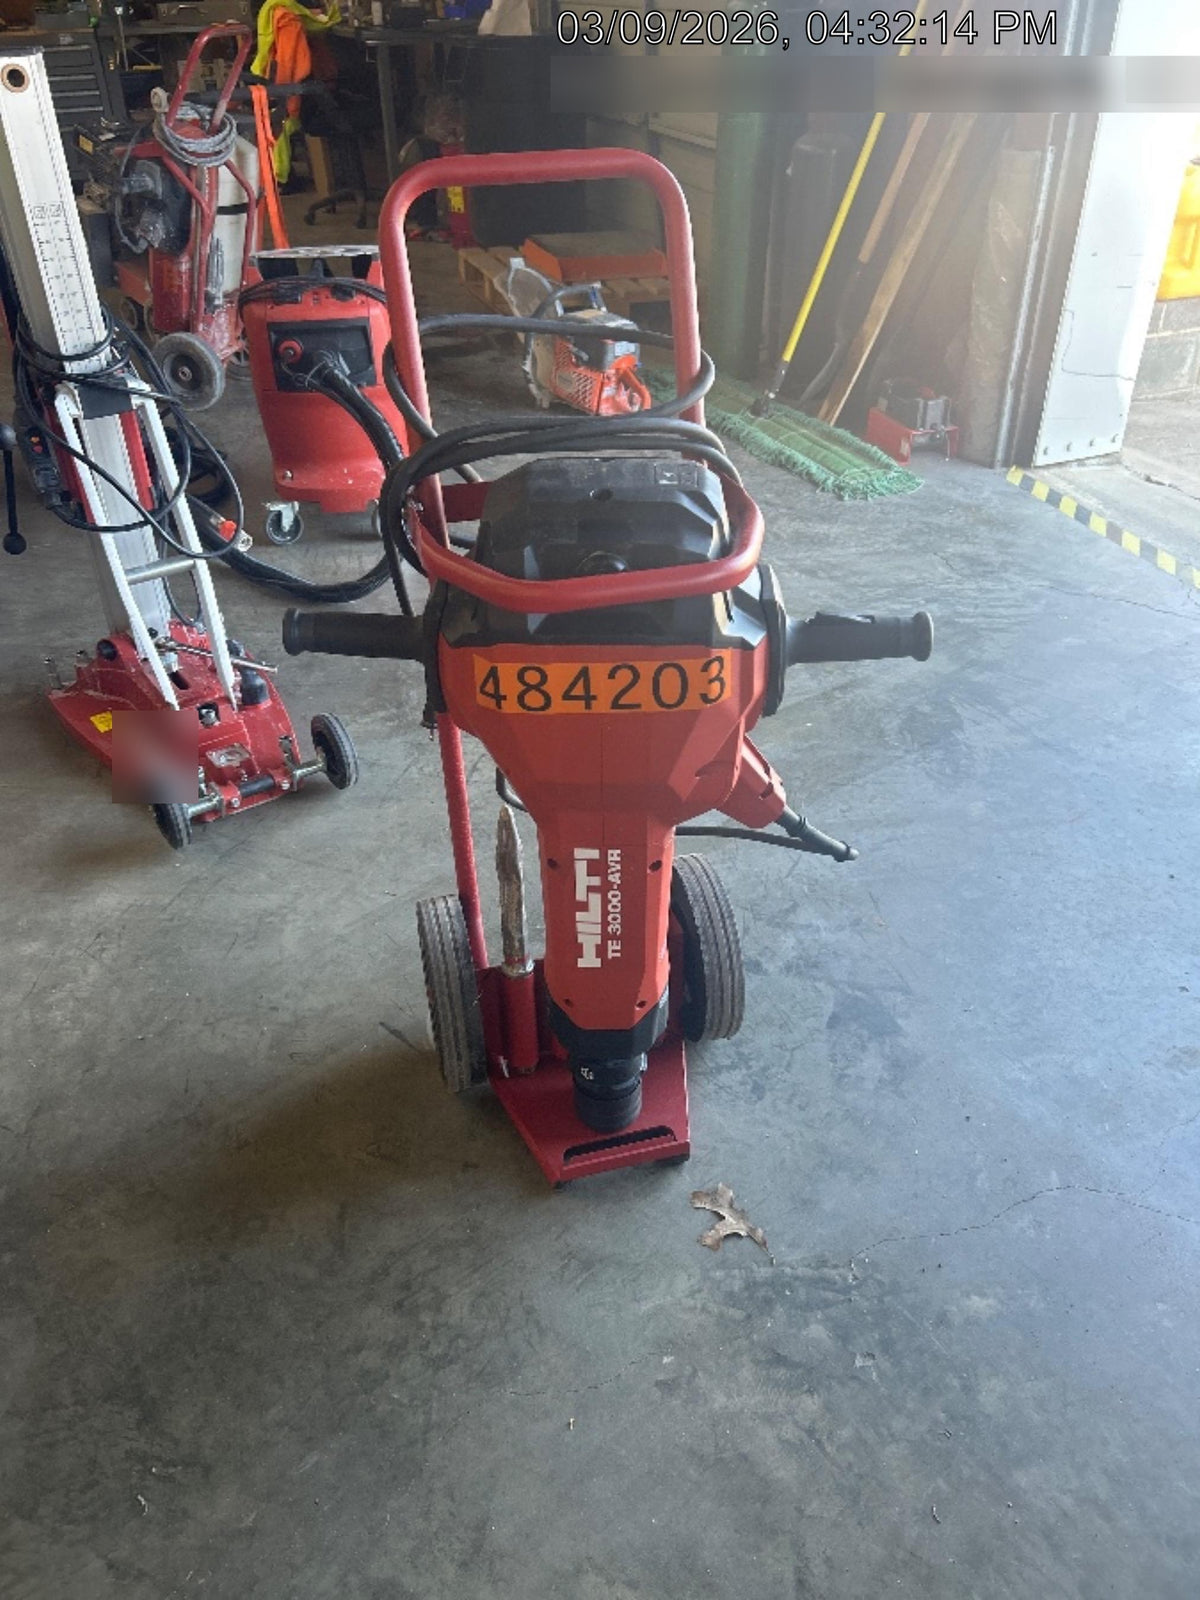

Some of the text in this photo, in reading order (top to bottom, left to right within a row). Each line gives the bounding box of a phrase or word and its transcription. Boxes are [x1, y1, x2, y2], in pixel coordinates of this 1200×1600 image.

[479, 655, 726, 712] 484203
[574, 848, 601, 968] HILTI
[608, 849, 621, 959] TE 3000-AVR
